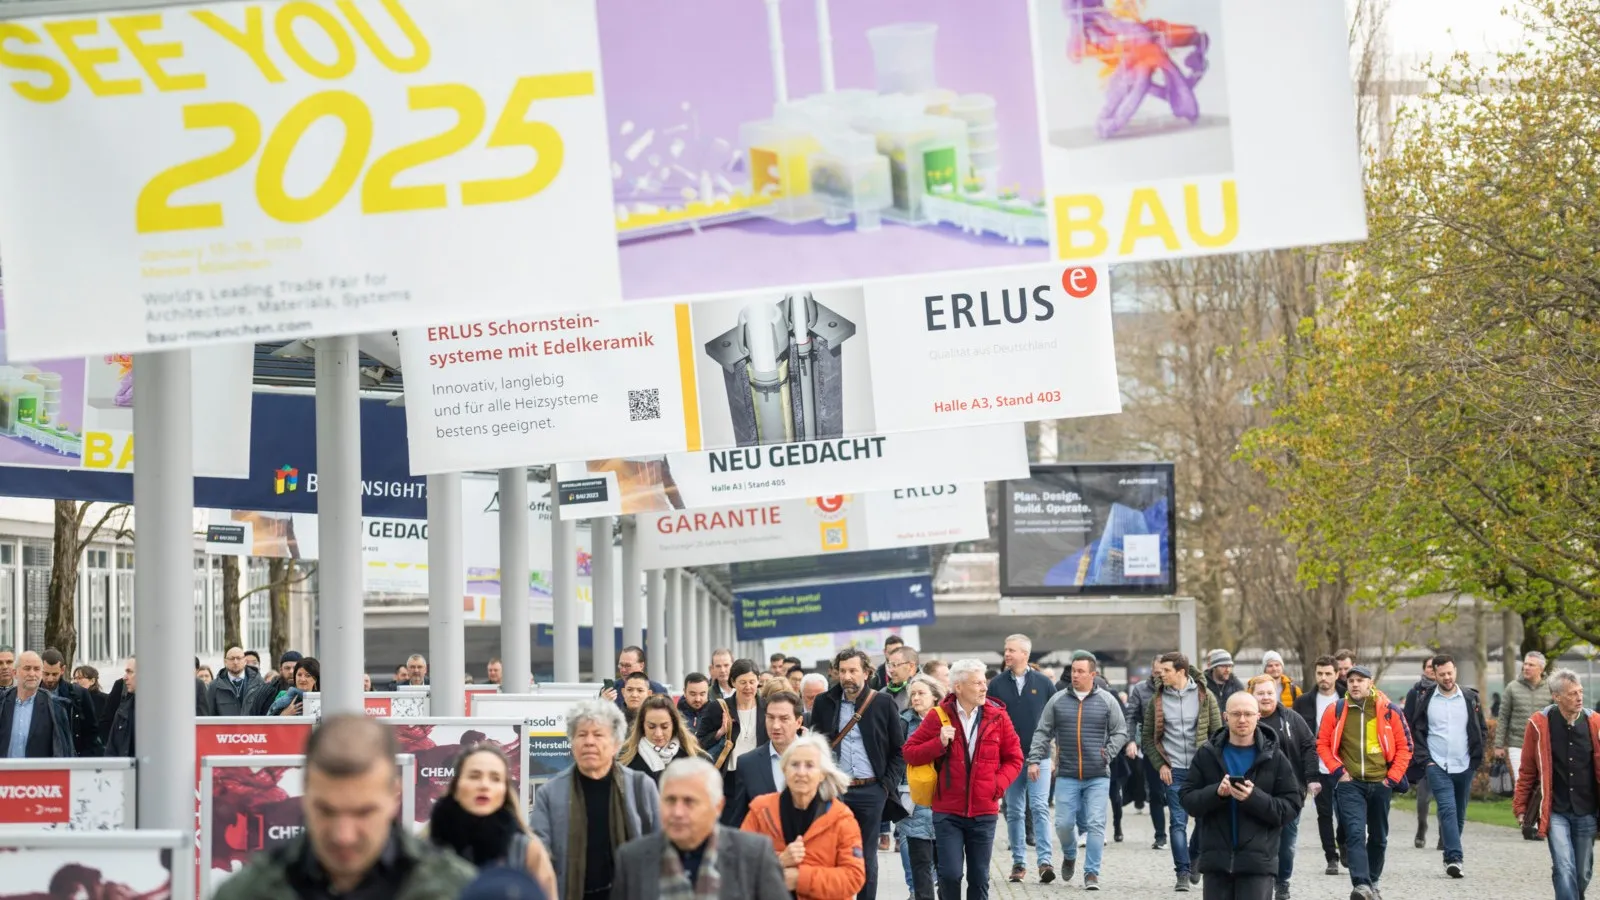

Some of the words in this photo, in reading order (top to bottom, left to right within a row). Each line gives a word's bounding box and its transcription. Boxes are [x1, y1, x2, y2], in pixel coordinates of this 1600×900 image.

[0, 14, 207, 104] SEE
[190, 0, 431, 84] YOU
[136, 71, 595, 234] 2025
[1053, 180, 1239, 260] BAU
[142, 288, 205, 306] World's
[210, 282, 274, 301] Leading
[278, 278, 323, 293] Trade
[329, 274, 358, 289] Fair
[364, 273, 388, 287] for
[342, 289, 411, 309] Systems
[924, 285, 1055, 331] ERLUS
[146, 320, 313, 343] bau-muenchen.com
[427, 322, 483, 341] ERLUS
[488, 313, 600, 337] Schornstein-
[429, 346, 503, 369] systeme
[508, 340, 539, 359] mit
[543, 331, 655, 356] Edelkeramik
[973, 348, 990, 357] aus
[993, 338, 1058, 354] Deutschland
[432, 379, 498, 396] Innovativ,
[501, 373, 565, 393] langlebig
[434, 403, 461, 417] und
[464, 400, 484, 415] für
[487, 398, 511, 413] alle
[515, 391, 599, 410] Heizsysteme
[934, 399, 967, 413] Halle
[971, 397, 993, 410] A3,
[995, 392, 1034, 408] Stand
[1037, 390, 1062, 404] 403
[436, 422, 489, 439] bestens
[491, 417, 556, 437] geeignet.
[83, 431, 134, 469] BA
[709, 448, 762, 473] NEU
[769, 436, 887, 467] GEDACHT
[361, 480, 428, 498] NSIGHT
[711, 481, 731, 492] Halle
[747, 479, 769, 489] Stand
[1013, 491, 1041, 502] Plan.
[1042, 490, 1082, 504] Design.
[657, 506, 782, 534] GARANTIE
[1013, 503, 1044, 514] Build.
[1046, 503, 1092, 515] Operate.
[742, 598, 756, 607] The
[758, 595, 795, 607] specialist
[796, 593, 821, 604] portal
[742, 609, 755, 618] for
[757, 608, 770, 617] the
[771, 604, 822, 615] construction
[744, 618, 777, 628] industry
[871, 611, 890, 622] BAU
[215, 733, 268, 744] WICONA
